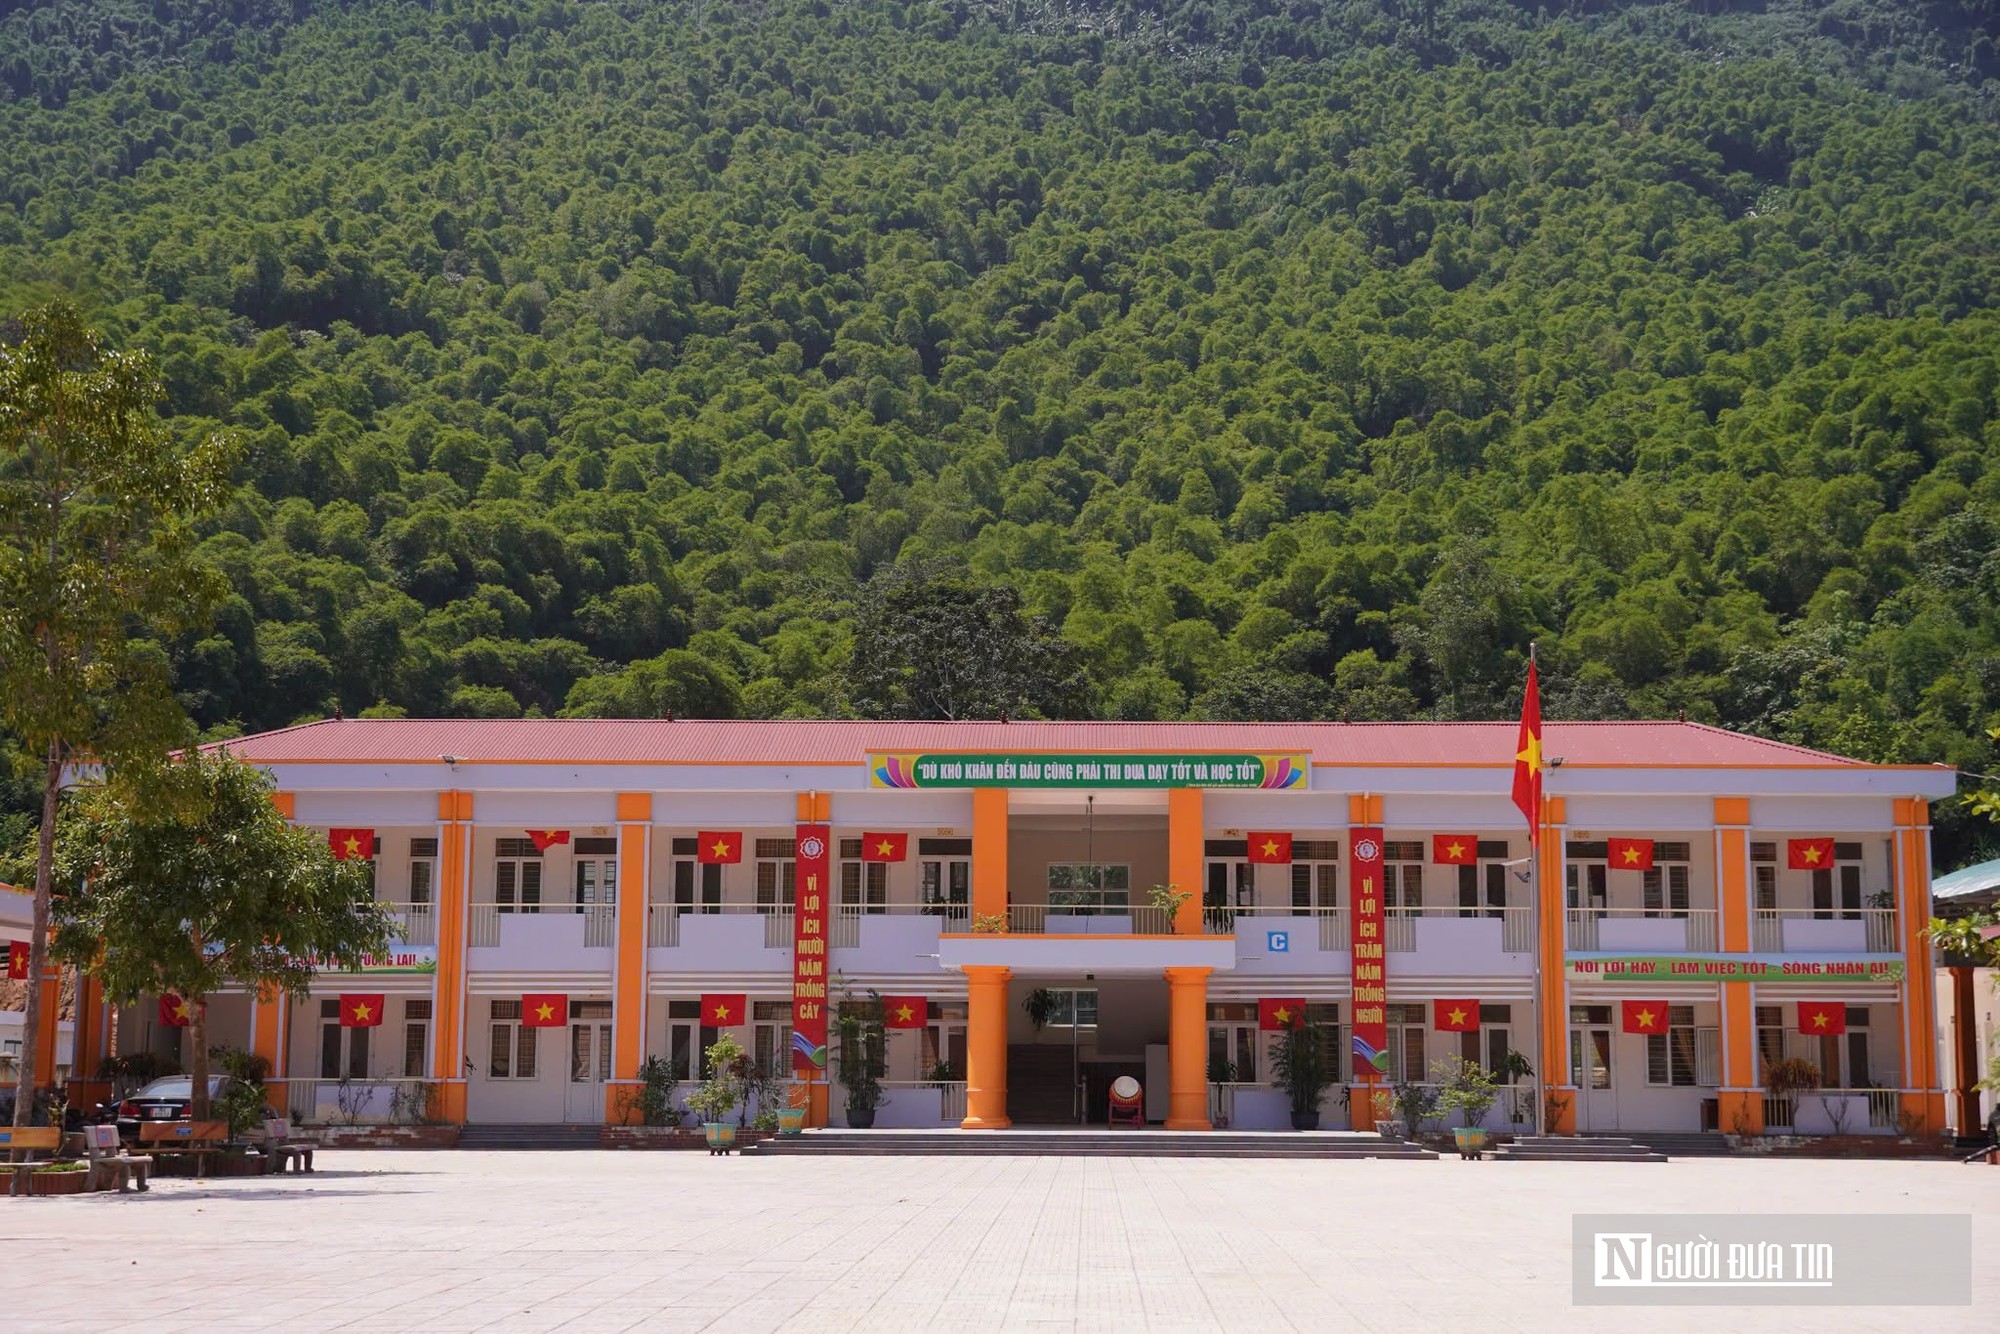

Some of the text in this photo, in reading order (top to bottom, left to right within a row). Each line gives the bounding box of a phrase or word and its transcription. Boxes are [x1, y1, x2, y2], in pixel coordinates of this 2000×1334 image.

[940, 761, 962, 780] KHÓ
[965, 761, 994, 780] KHĂN
[1044, 761, 1073, 780] CŨNG
[1076, 760, 1101, 780] PHẢI
[1103, 764, 1121, 780] THI
[1148, 764, 1168, 783] DẠY
[1171, 759, 1191, 780] TỐT
[1193, 761, 1209, 780] VÀ
[1211, 764, 1233, 783] HỌC
[807, 873, 817, 891] VÌ
[1363, 876, 1373, 894] VÌ
[804, 894, 820, 914] LỢI
[1360, 898, 1376, 917] LỢI
[803, 916, 820, 934] ÍCH
[1360, 920, 1377, 938] ÍCH
[798, 936, 824, 955] MƯỜI
[1271, 934, 1286, 950] C
[1354, 941, 1383, 958] TRĂM
[799, 958, 822, 976] NĂM
[1356, 962, 1381, 980] NĂM
[1630, 962, 1656, 974] HAY
[800, 1001, 820, 1019] CÂY
[1356, 1005, 1383, 1024] NGƯỜI
